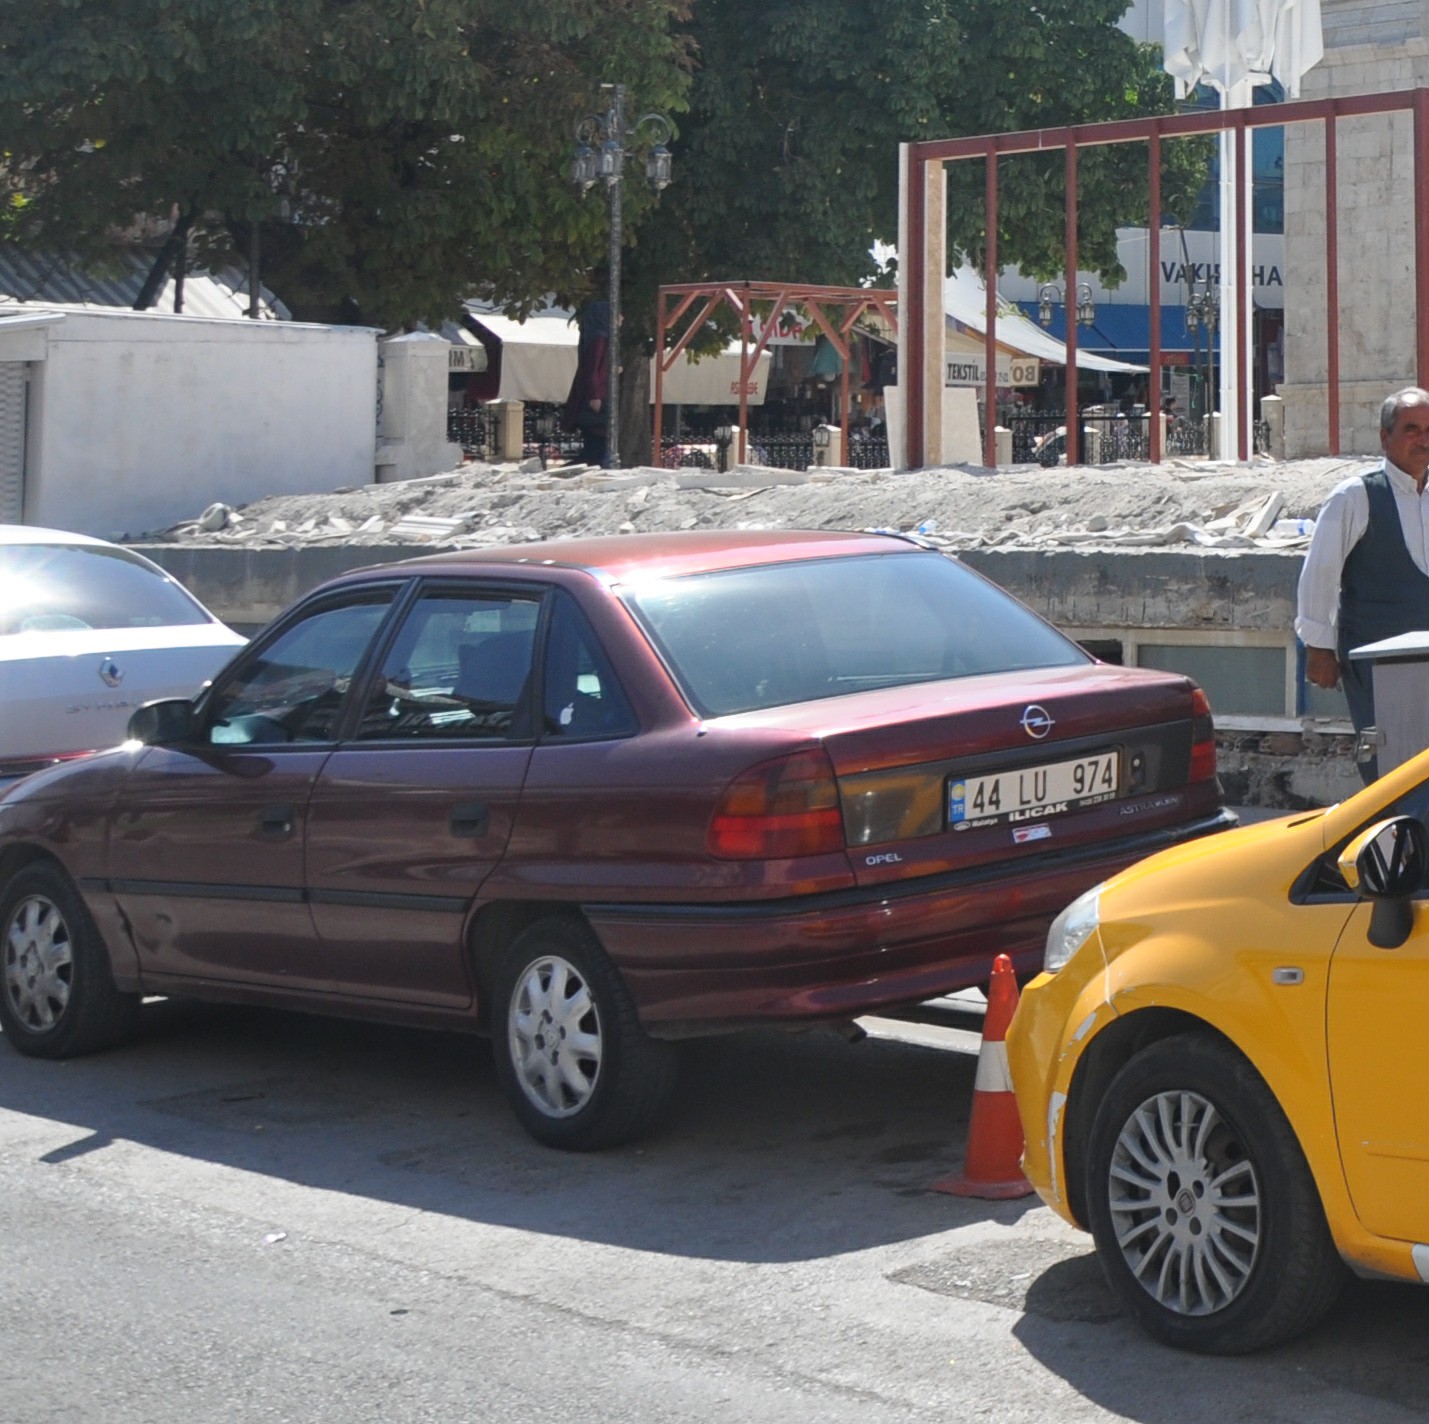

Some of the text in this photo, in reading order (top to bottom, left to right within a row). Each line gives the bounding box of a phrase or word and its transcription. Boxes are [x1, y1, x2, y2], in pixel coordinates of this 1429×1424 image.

[972, 779, 1001, 814] 44
[1019, 770, 1047, 806] LU
[1073, 758, 1113, 794] 974
[866, 853, 902, 865] OPEL
